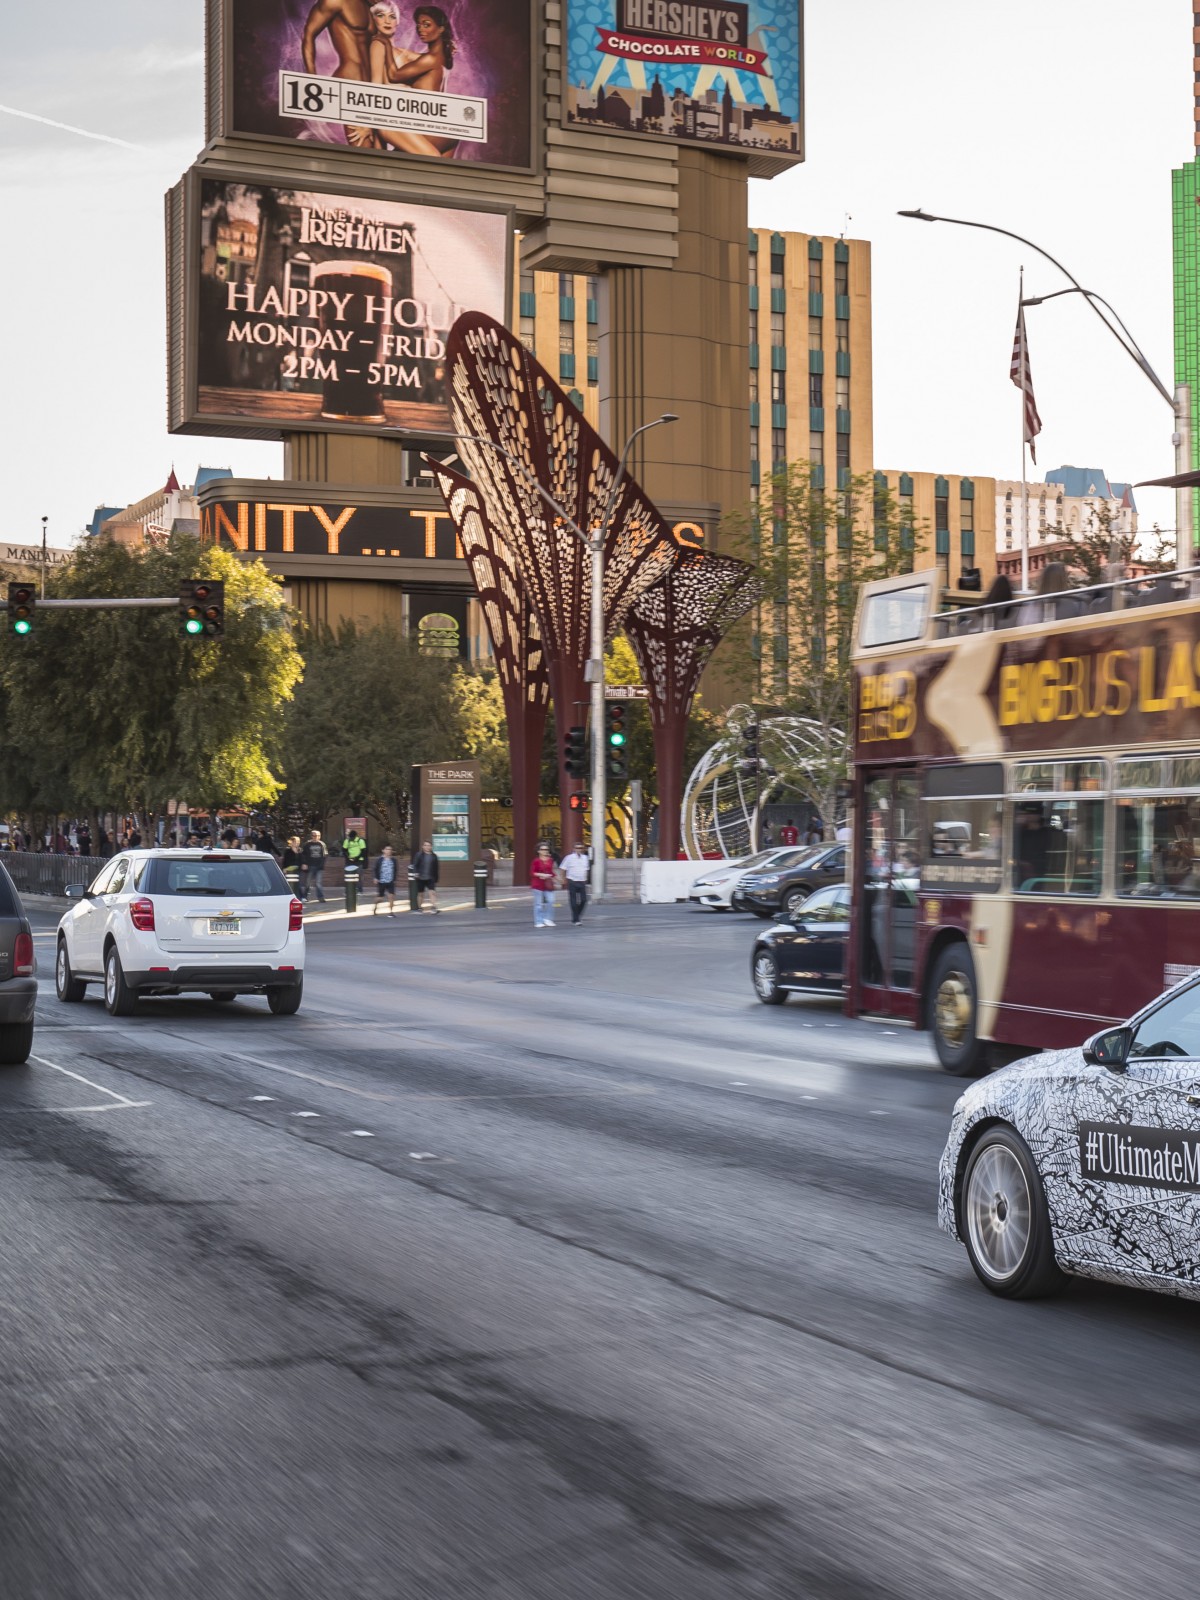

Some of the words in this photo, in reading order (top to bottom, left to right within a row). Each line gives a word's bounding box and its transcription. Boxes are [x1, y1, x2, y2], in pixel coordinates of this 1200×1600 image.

[627, 0, 739, 42] HERSHEY'S
[607, 37, 701, 56] CHOCOLATE
[703, 46, 756, 65] WORLD
[287, 80, 338, 112] 18+
[347, 91, 392, 110] RATED
[396, 98, 448, 117] CIRQUE
[298, 207, 418, 254] IRISHMEN
[310, 205, 348, 223] NINE
[225, 281, 354, 321] HAPPY
[226, 320, 354, 352] MONDAY
[381, 334, 446, 361] FRID
[283, 355, 339, 382] 2PM
[367, 363, 422, 388] 5PM
[428, 769, 447, 778] THE
[447, 770, 474, 779] PARK
